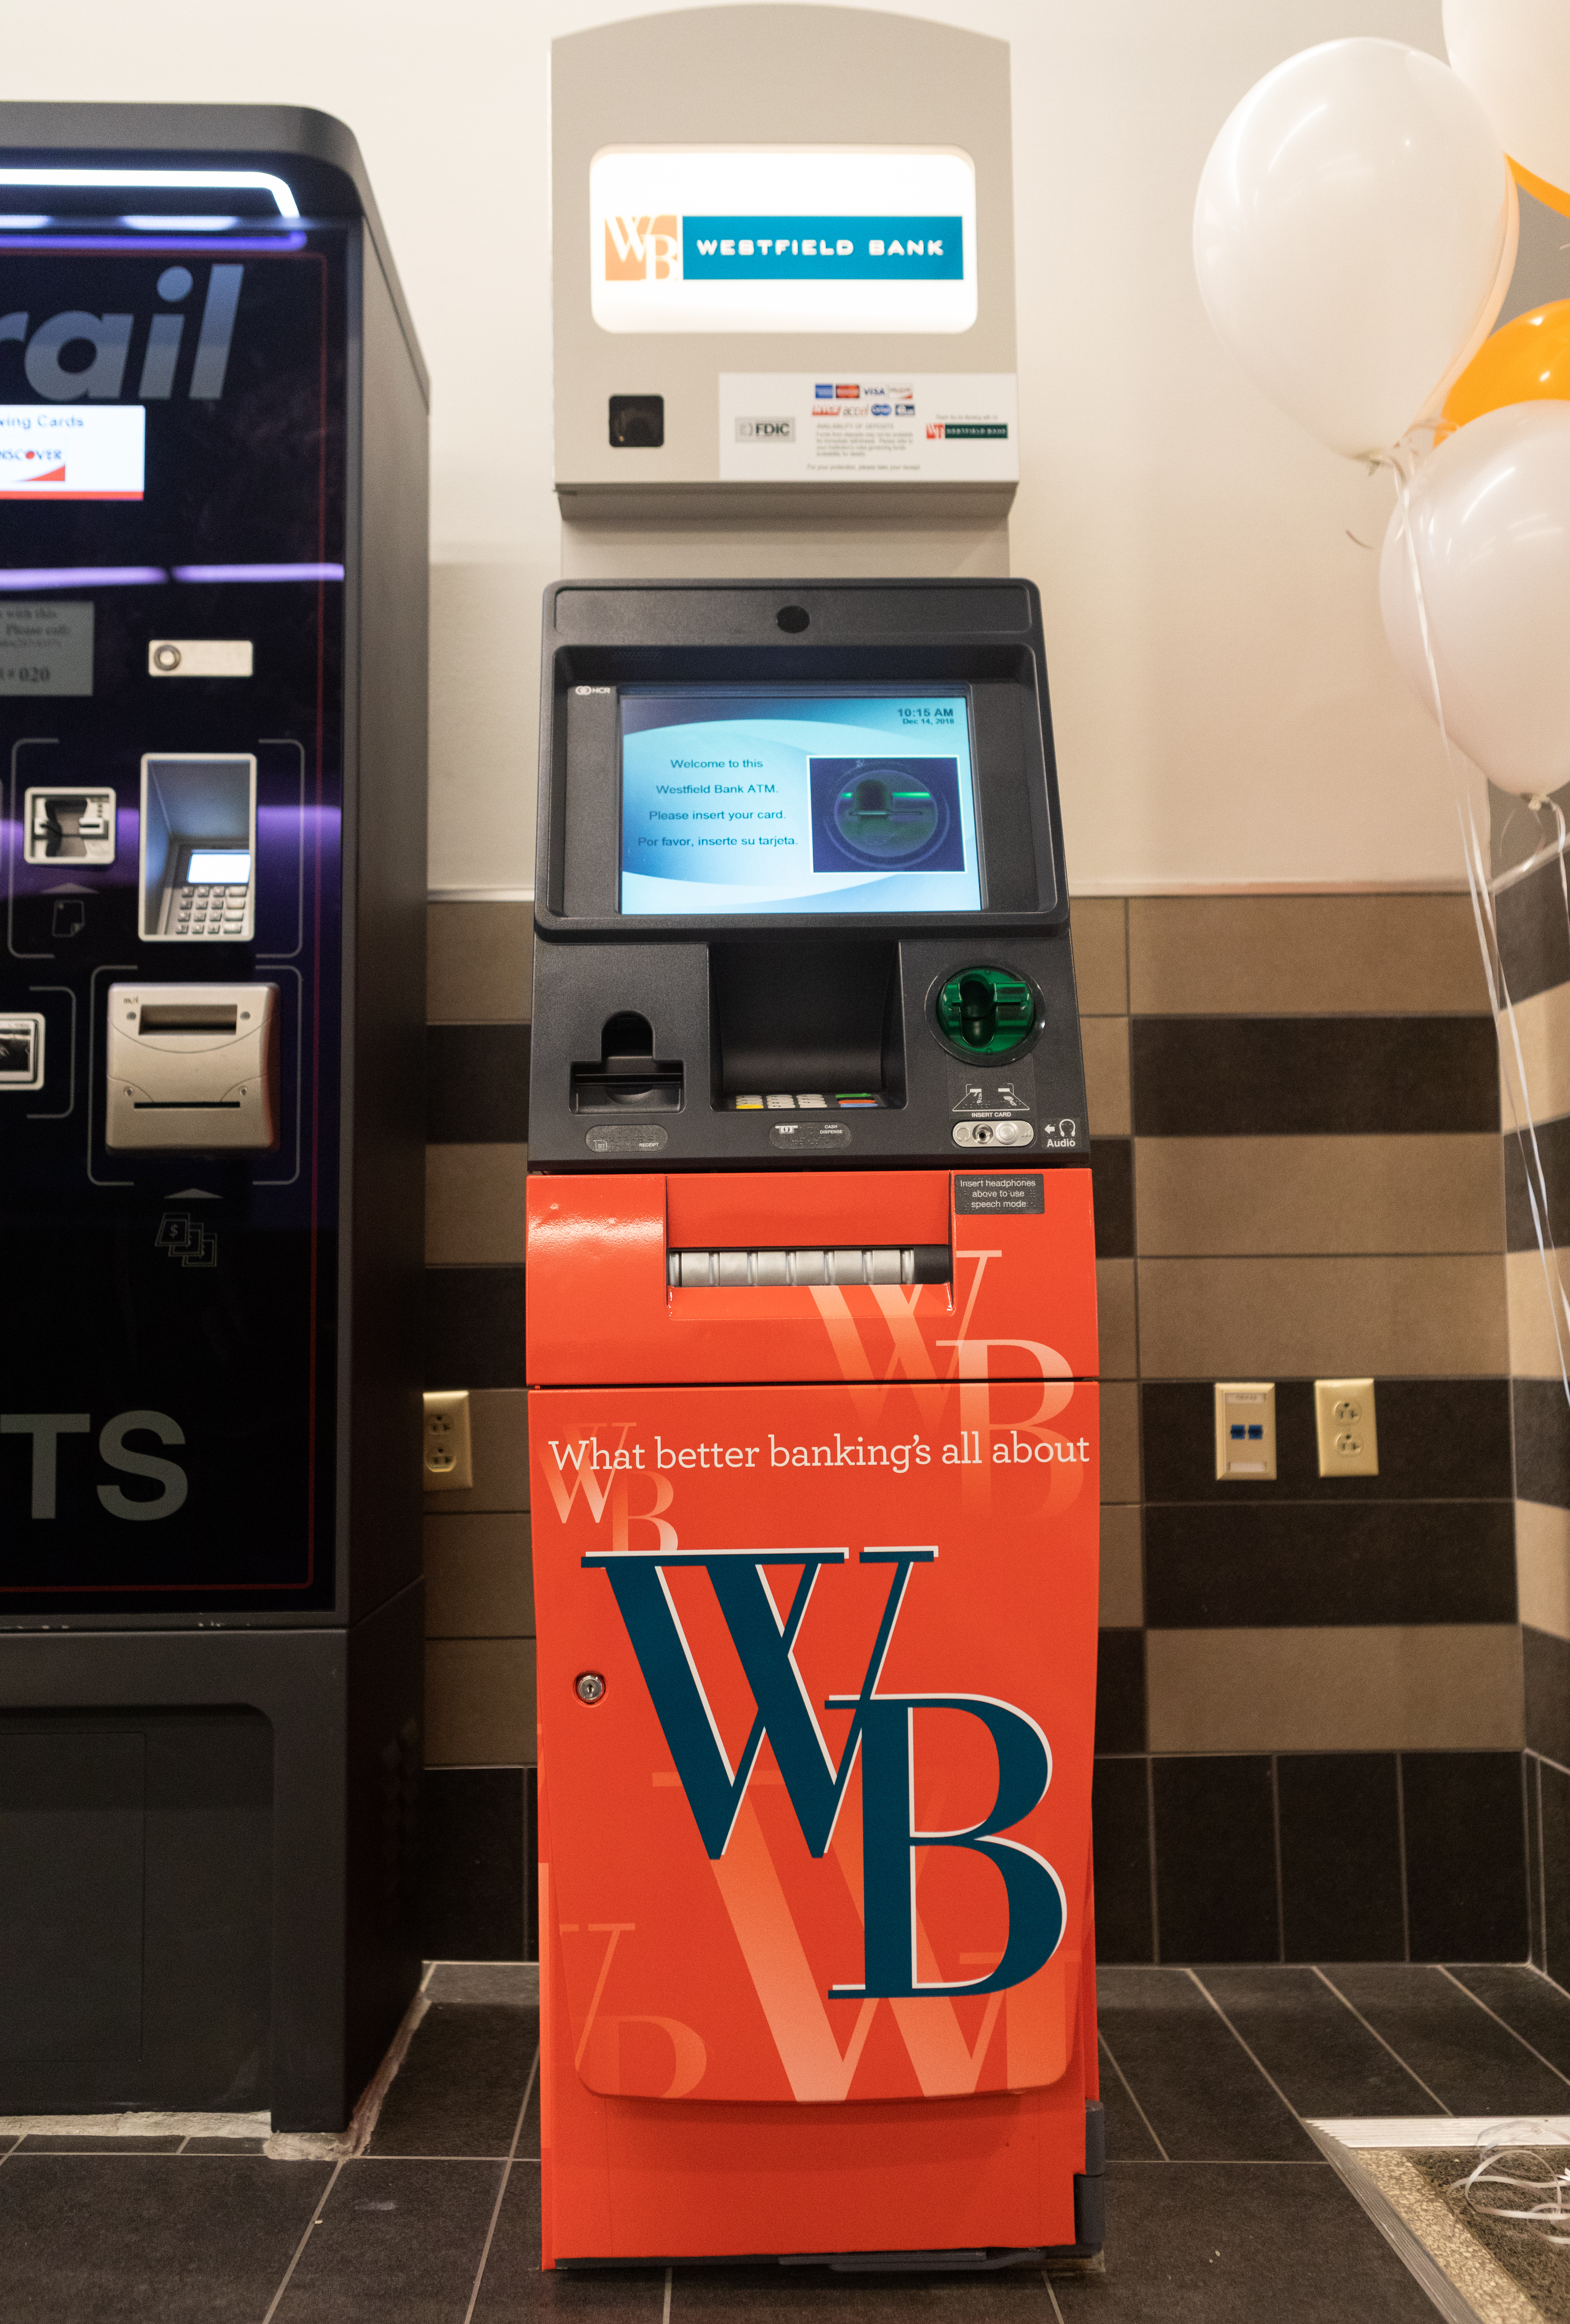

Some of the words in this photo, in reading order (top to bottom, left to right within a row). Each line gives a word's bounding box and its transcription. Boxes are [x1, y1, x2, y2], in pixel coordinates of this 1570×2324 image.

[696, 239, 854, 256] WESTFIELD
[869, 239, 944, 256] BANK
[37, 413, 83, 427] Cards
[756, 423, 789, 436] FDIC
[898, 708, 931, 717] 10:15
[934, 708, 953, 717] AM
[670, 758, 726, 769] Welcome
[729, 759, 739, 768] to
[743, 758, 763, 768] this
[656, 784, 712, 795] Westfield
[715, 784, 744, 795] Bank
[747, 784, 779, 795] ATM.
[649, 810, 688, 820] Please
[693, 810, 725, 820] insert
[728, 812, 753, 821] your
[757, 809, 786, 820] card.
[638, 836, 659, 846] Por
[662, 835, 695, 848] favor,
[698, 835, 737, 846] inserte
[741, 837, 755, 846] su
[759, 835, 798, 848] tarjeta.
[1047, 1139, 1076, 1147] Audio
[986, 1179, 1036, 1188] headphones
[971, 1201, 1001, 1209] speech
[548, 1437, 645, 1470] What
[655, 1436, 760, 1469] better
[942, 1431, 983, 1464] all
[991, 1430, 1090, 1464] about
[581, 1546, 1067, 1999] WB
